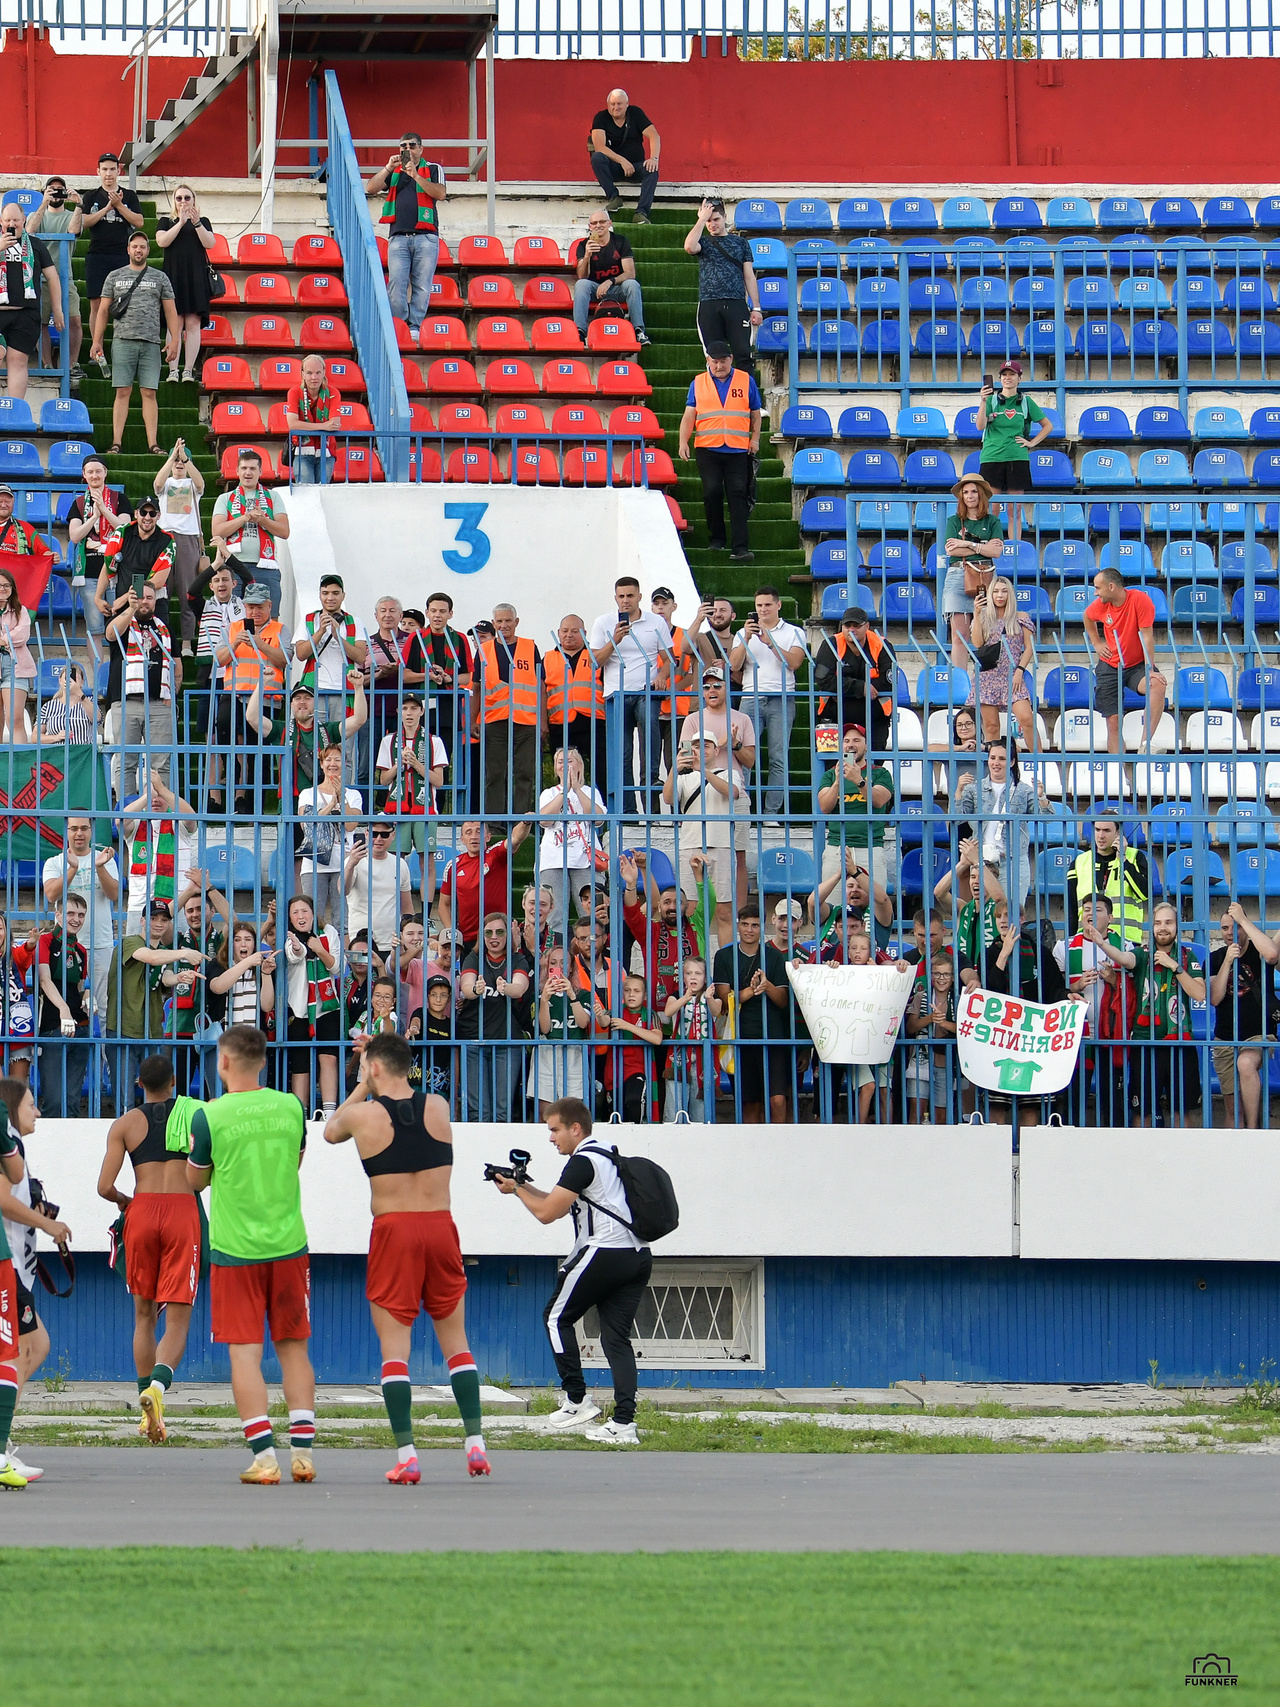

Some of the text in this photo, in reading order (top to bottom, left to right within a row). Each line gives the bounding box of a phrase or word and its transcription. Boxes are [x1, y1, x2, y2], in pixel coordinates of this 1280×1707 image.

[731, 389, 743, 399] 83
[442, 502, 491, 574] 3
[516, 659, 529, 671] 65
[241, 1138, 289, 1202] 17
